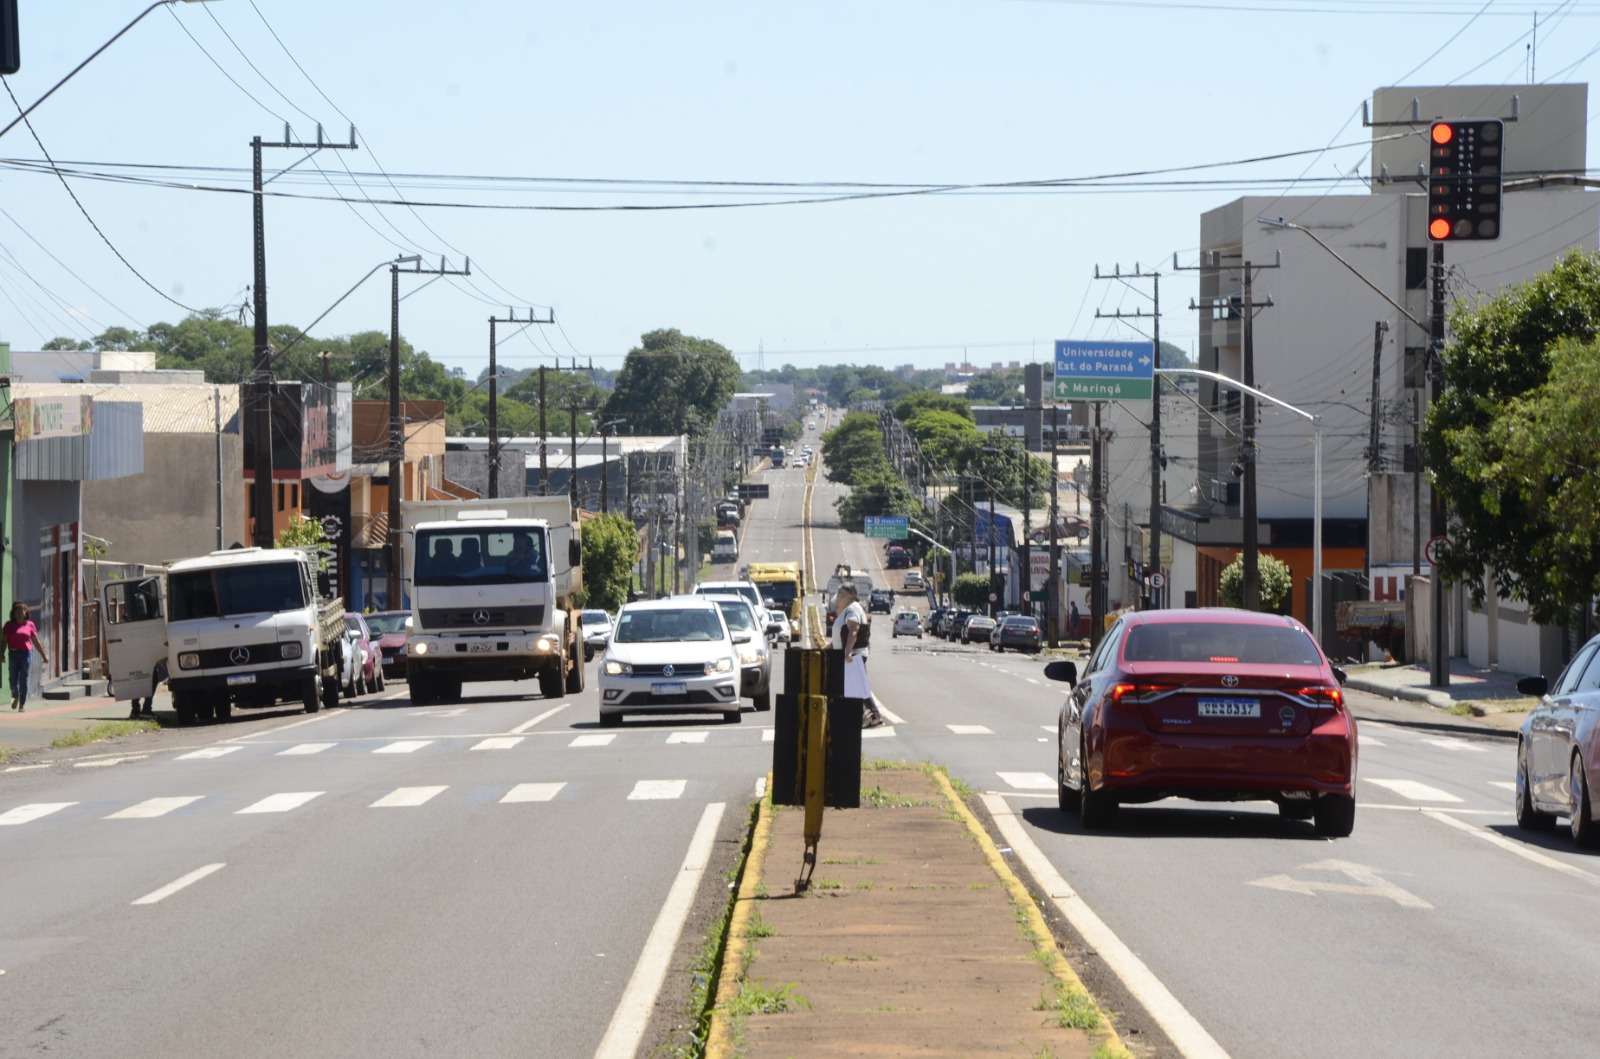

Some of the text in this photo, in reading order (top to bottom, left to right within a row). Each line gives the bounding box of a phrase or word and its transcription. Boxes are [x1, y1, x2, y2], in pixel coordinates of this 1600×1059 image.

[1063, 347, 1134, 358] Universidade
[1057, 361, 1134, 372] Est. do Paraná
[1073, 383, 1121, 395] Maringá
[1153, 575, 1161, 586] E
